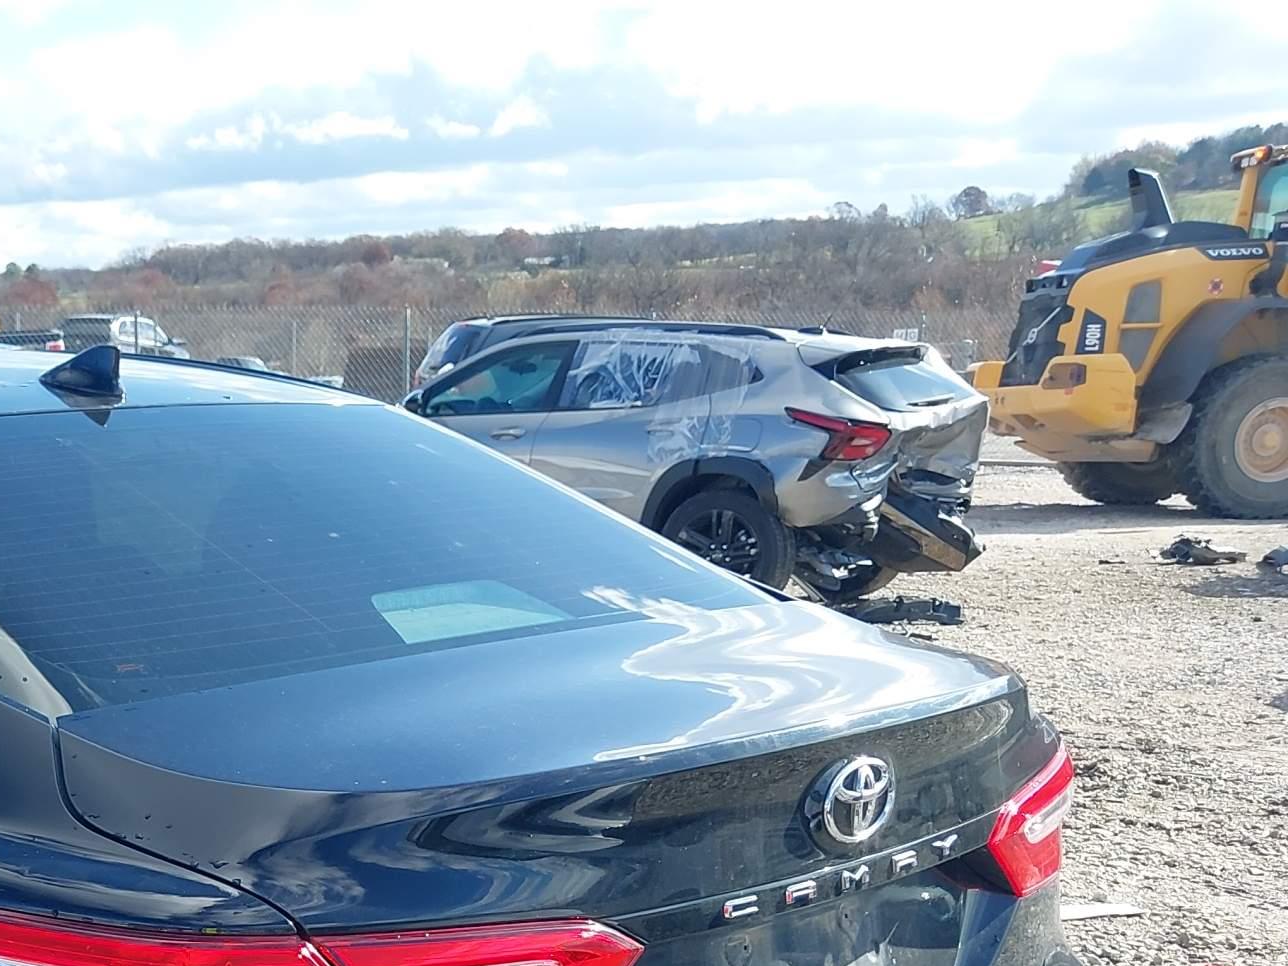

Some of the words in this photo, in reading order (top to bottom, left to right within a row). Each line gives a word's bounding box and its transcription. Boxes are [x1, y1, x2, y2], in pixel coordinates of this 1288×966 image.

[1206, 247, 1264, 257] VOLVO
[1084, 324, 1103, 351] L90H
[722, 834, 958, 920] CAMRY
